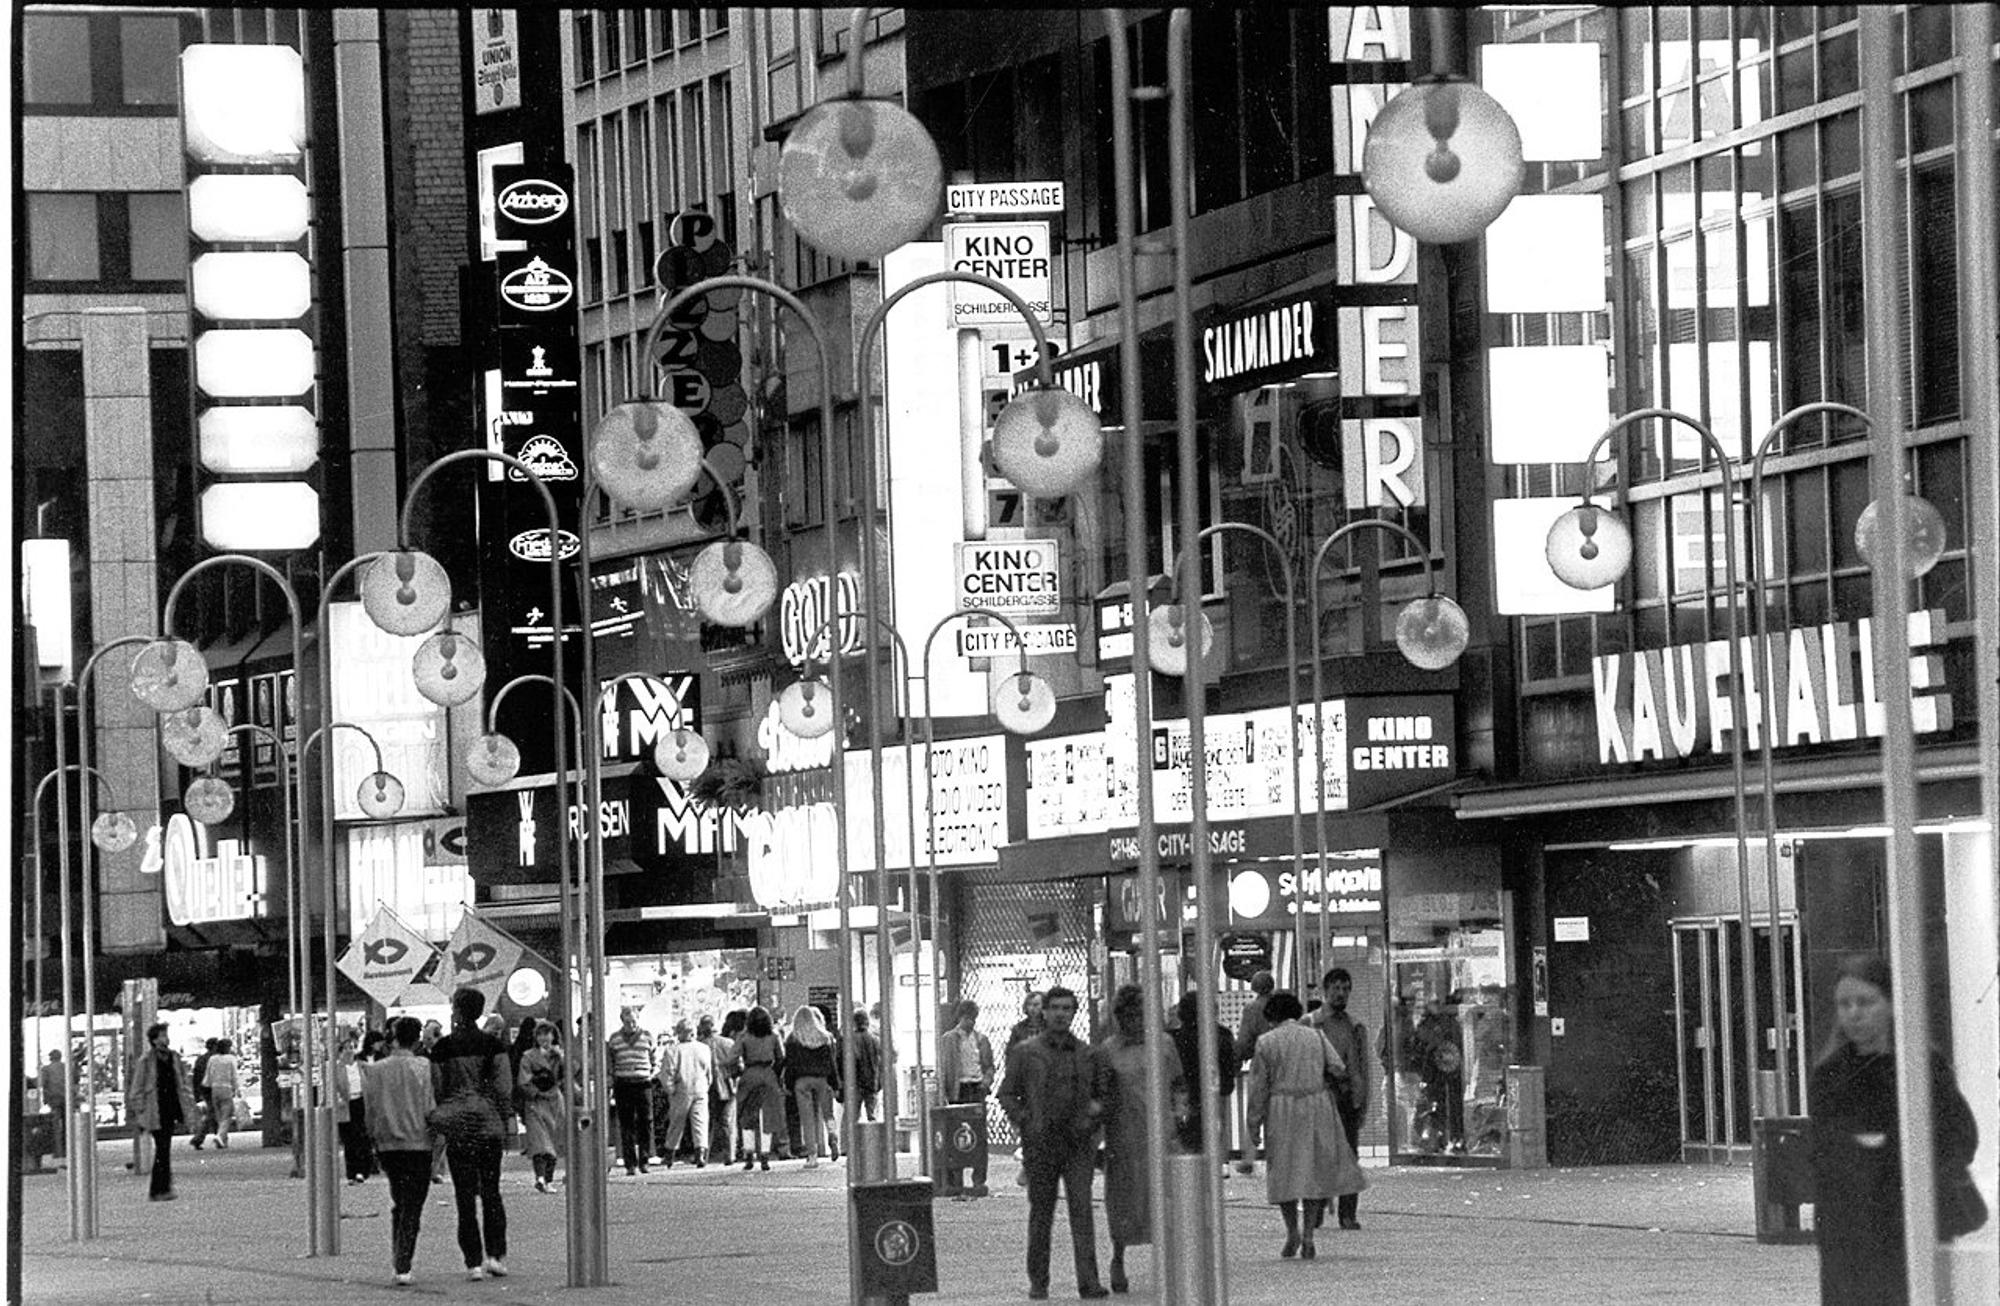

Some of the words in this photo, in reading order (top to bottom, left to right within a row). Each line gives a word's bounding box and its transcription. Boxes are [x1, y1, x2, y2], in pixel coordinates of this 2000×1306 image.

[951, 189, 985, 208] CITY
[990, 187, 1061, 207] PASSAGE
[966, 236, 1033, 256] KINO
[954, 258, 1048, 278] CENTER
[1203, 300, 1315, 383] SALAMANDER
[975, 549, 1042, 571] KINO
[963, 571, 1058, 594] CENTER
[965, 632, 999, 652] CITY
[1592, 608, 1940, 765] KAUFHALLE
[1368, 716, 1432, 741] KINO
[925, 749, 953, 778] OTO
[960, 745, 988, 774] KINO
[1353, 745, 1449, 771] CENTER
[924, 786, 960, 816] UDIO
[924, 821, 999, 855] EECTRONIC
